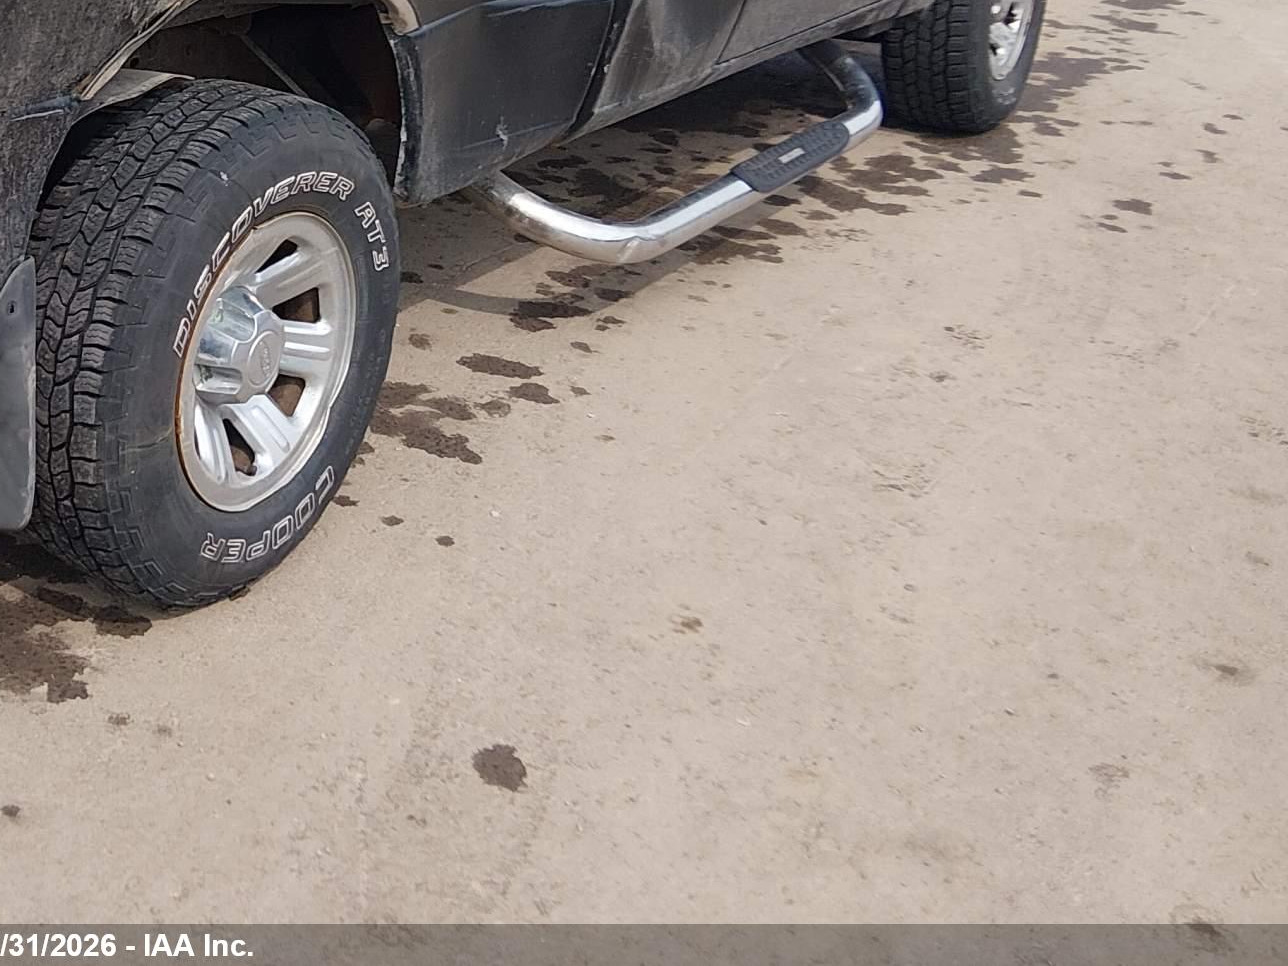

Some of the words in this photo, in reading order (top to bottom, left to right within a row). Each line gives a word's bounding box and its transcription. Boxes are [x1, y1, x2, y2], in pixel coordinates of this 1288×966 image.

[172, 170, 356, 359] DISCOVERER
[353, 200, 390, 272] AT3
[199, 464, 335, 564] COOPER
